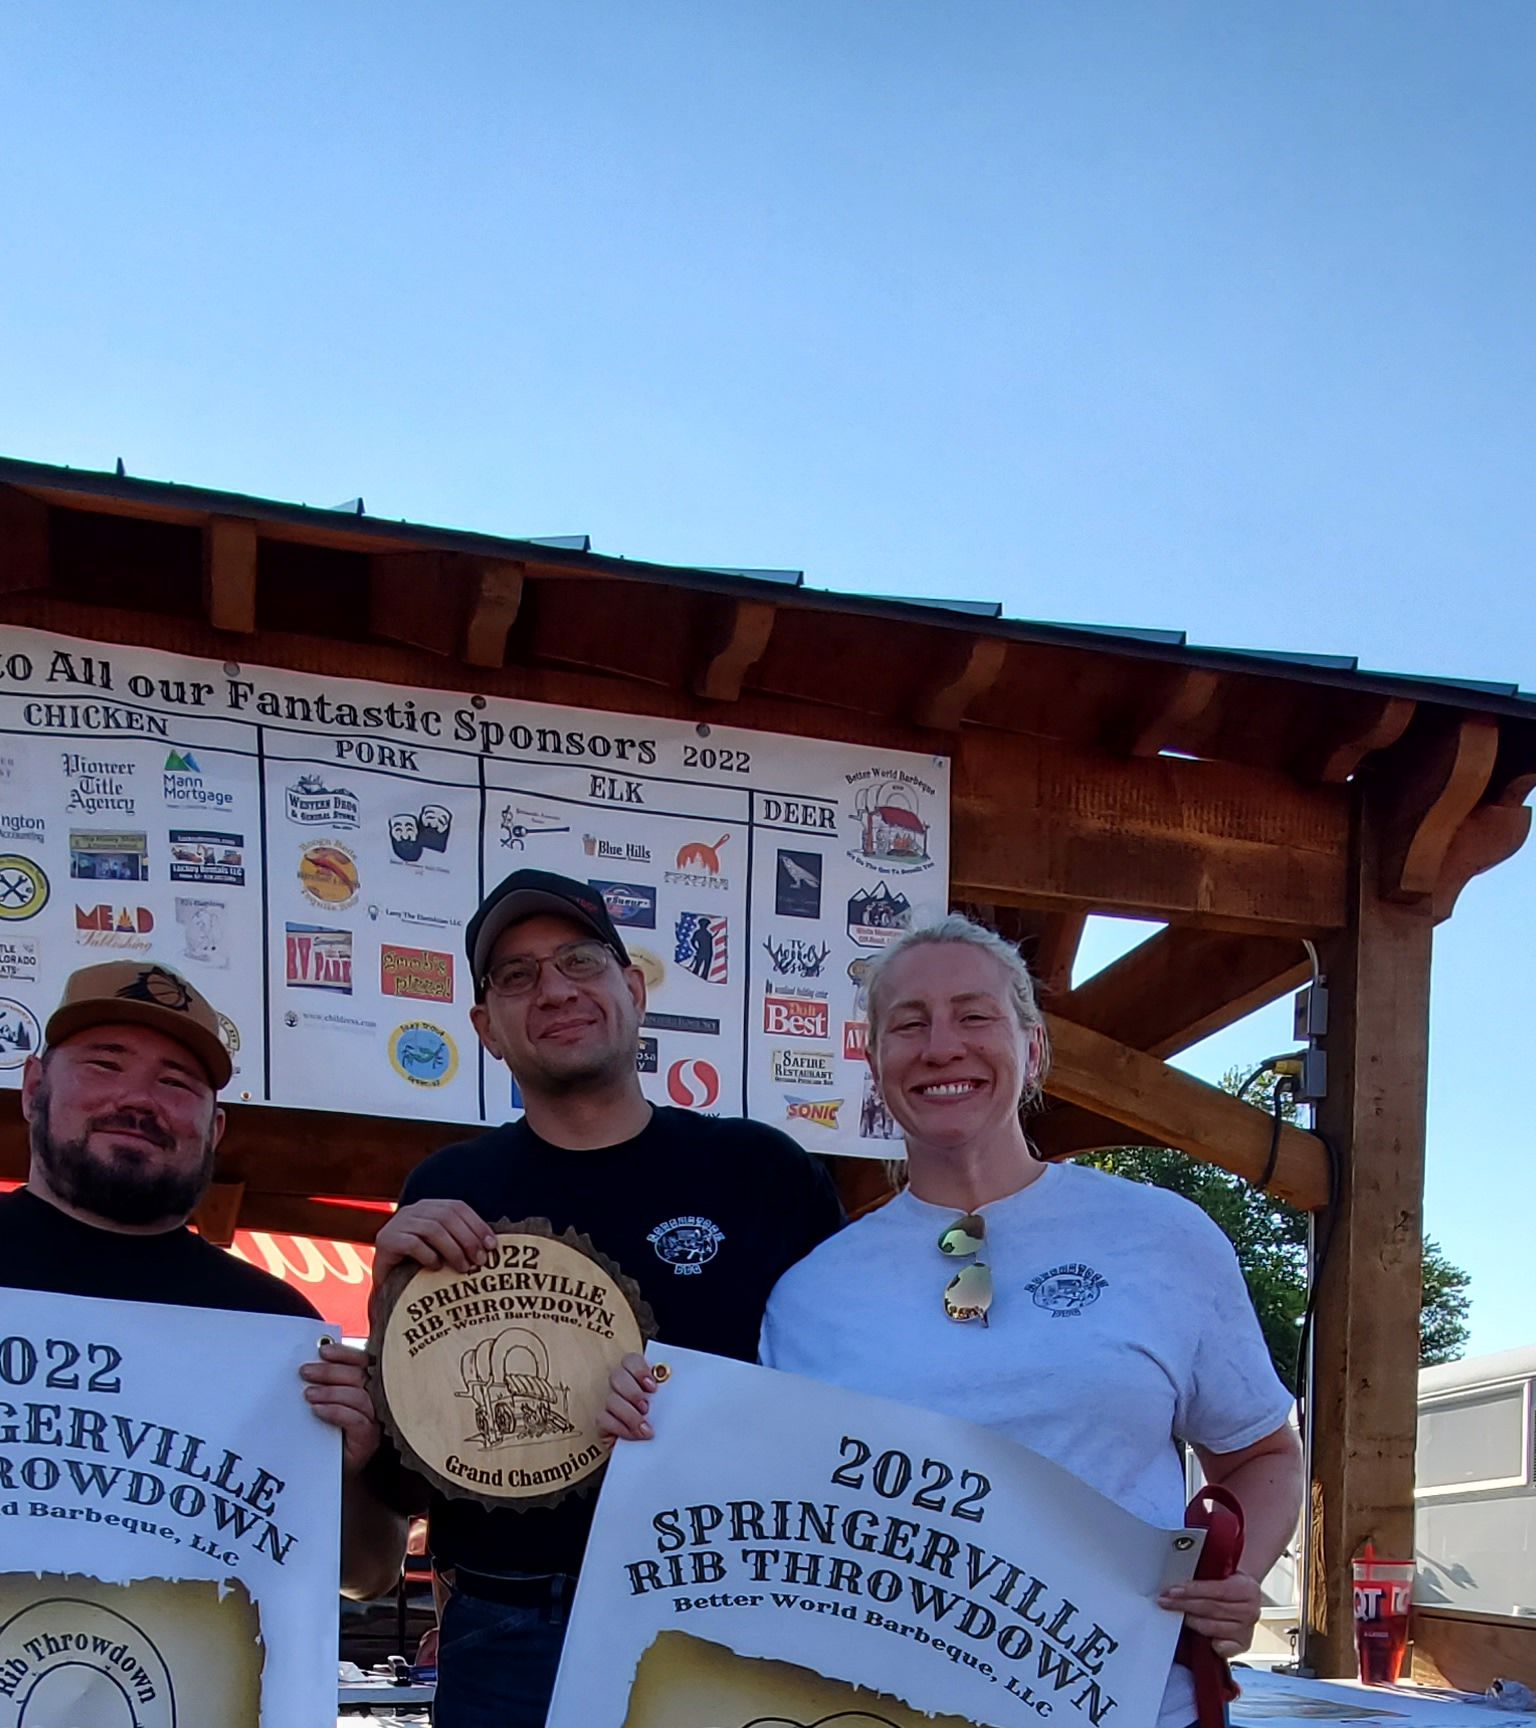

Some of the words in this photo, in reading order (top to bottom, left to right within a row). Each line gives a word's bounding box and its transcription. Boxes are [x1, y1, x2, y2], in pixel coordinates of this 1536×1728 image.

[23, 702, 169, 736] CHICKEN
[46, 650, 114, 690] All
[129, 675, 213, 706] our
[227, 679, 441, 737] Fantastic
[454, 708, 657, 765] Sponsors
[683, 745, 751, 774] 2022
[61, 752, 136, 777] Pioneer
[335, 739, 420, 772] PORK
[79, 774, 123, 796] Title
[164, 774, 203, 788] Mann
[164, 787, 233, 806] Mortgage
[589, 774, 644, 804] ELK
[845, 771, 871, 785] Better
[872, 767, 898, 780] World
[898, 771, 936, 796] Barbeque
[66, 789, 136, 816] Agency
[288, 792, 331, 810] WESTERN
[763, 799, 837, 829] DEER
[598, 840, 623, 857] Blue
[626, 843, 652, 860] Hills
[75, 904, 154, 934] MEAD
[403, 911, 416, 920] The
[286, 937, 312, 980] RV
[314, 950, 352, 983] PARK
[766, 1004, 827, 1037] Best
[775, 1063, 834, 1080] RESTAURANT
[782, 1050, 827, 1070] SAFIRE
[787, 1103, 839, 1121] SONIC
[406, 1272, 608, 1323] SPRINGERVILLE
[402, 1312, 444, 1347] RIB
[446, 1296, 617, 1328] THROWDOWN
[408, 1325, 452, 1358] Better
[453, 1311, 502, 1332] World
[504, 1310, 583, 1329] Barbeque,
[445, 1454, 504, 1488] Grand
[508, 1442, 603, 1488] Champion
[830, 1434, 993, 1523] 2022
[28, 1501, 183, 1546] Barbeque,
[623, 1549, 728, 1597] RIB
[652, 1500, 1120, 1676] SPRINGERVILLE
[1353, 1587, 1383, 1621] QT
[673, 1591, 764, 1614] Better
[769, 1592, 857, 1621] World
[863, 1608, 998, 1684] Barbeque,
[25, 1630, 157, 1706] Throwdown
